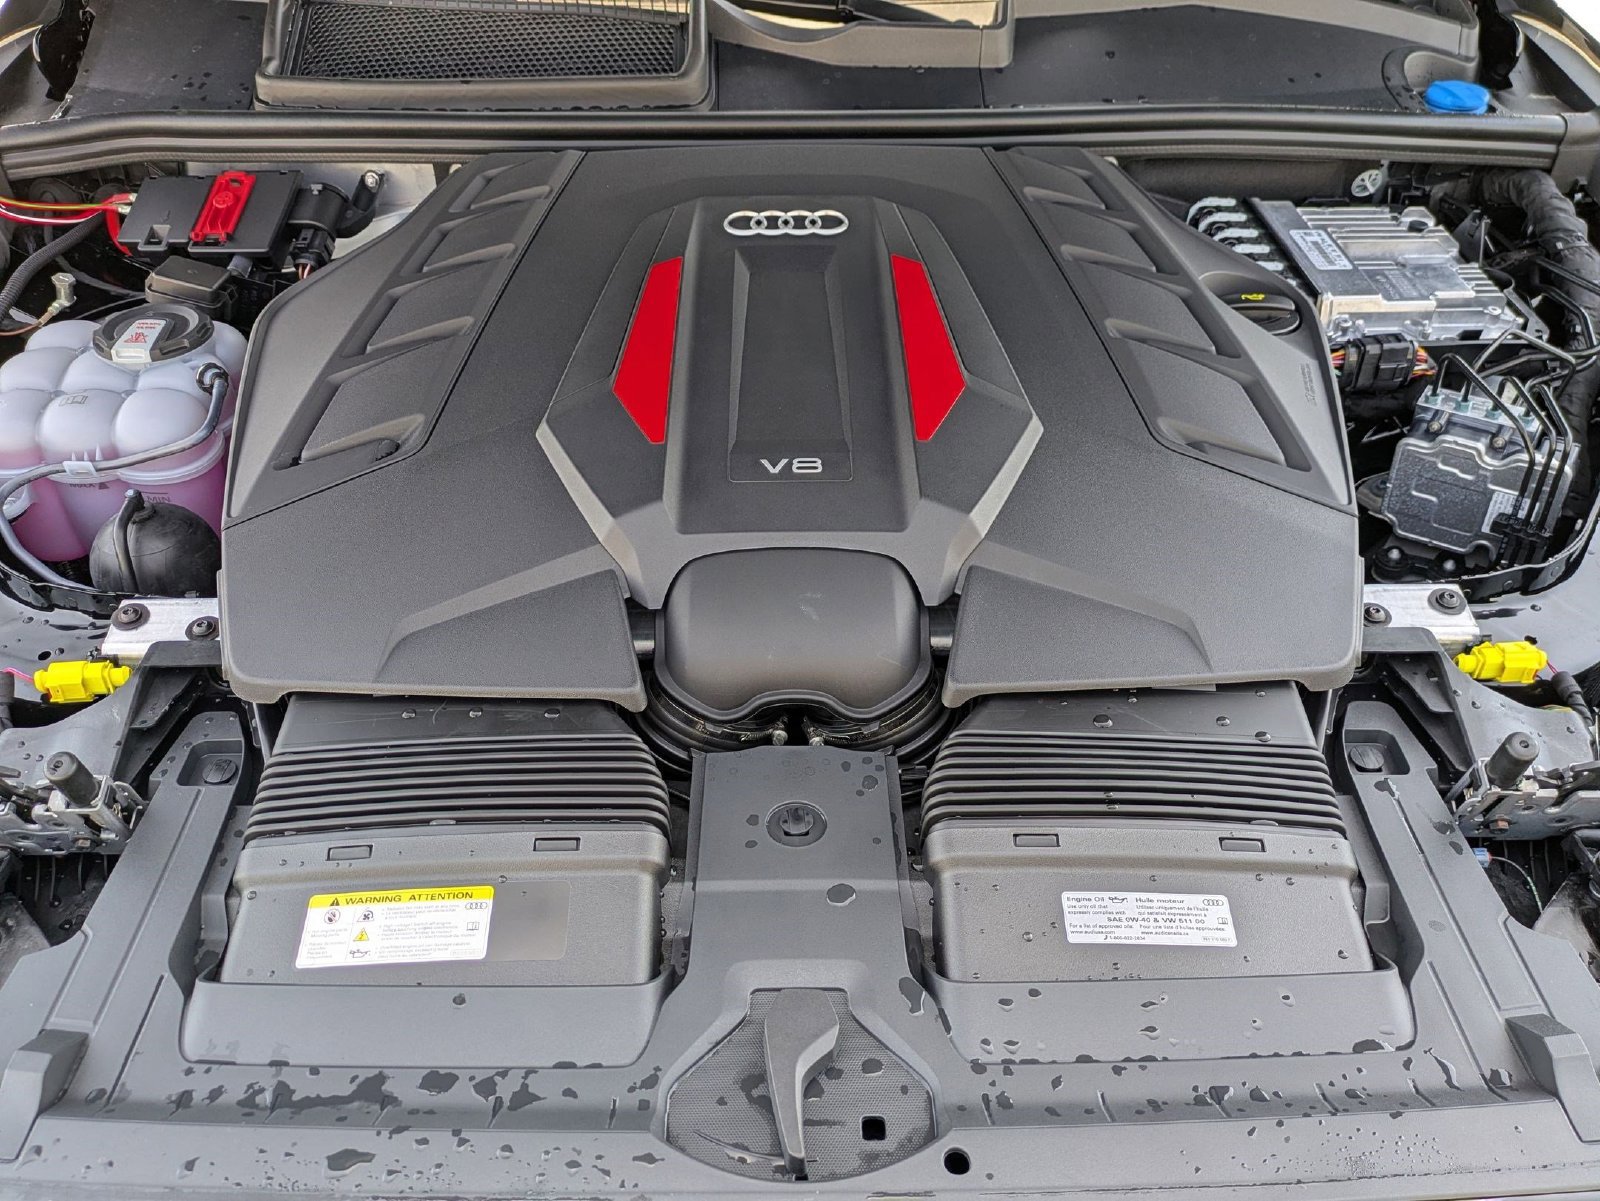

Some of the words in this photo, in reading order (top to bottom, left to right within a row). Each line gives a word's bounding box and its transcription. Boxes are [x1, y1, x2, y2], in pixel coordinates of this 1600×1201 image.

[760, 458, 822, 473] V8
[345, 894, 402, 905] WARNING
[409, 892, 474, 902] ATTENTION
